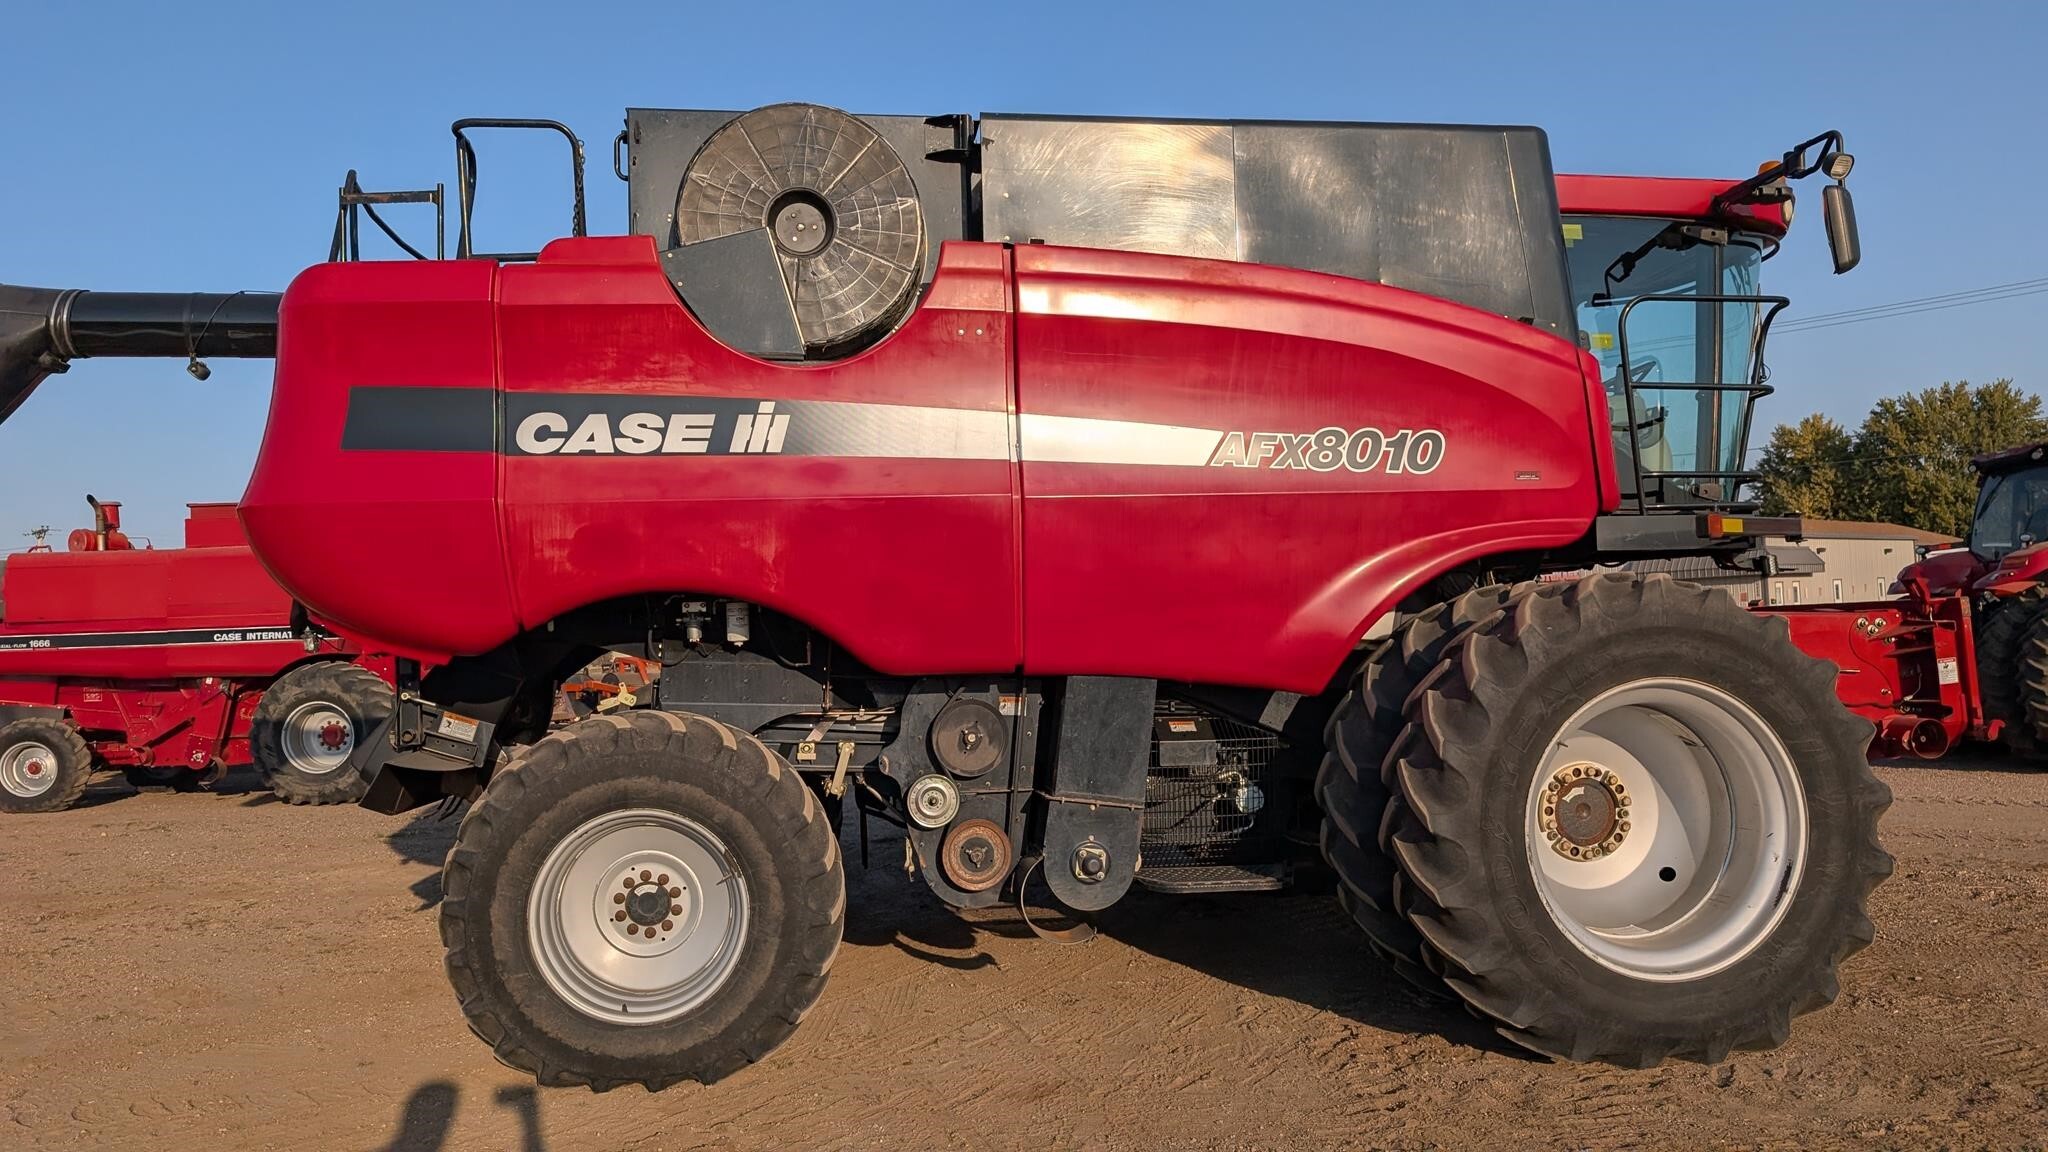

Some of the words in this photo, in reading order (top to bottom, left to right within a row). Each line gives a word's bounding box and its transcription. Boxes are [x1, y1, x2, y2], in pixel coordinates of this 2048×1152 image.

[515, 412, 716, 454] CASE
[213, 633, 242, 641] CASE
[29, 640, 51, 648] 1666
